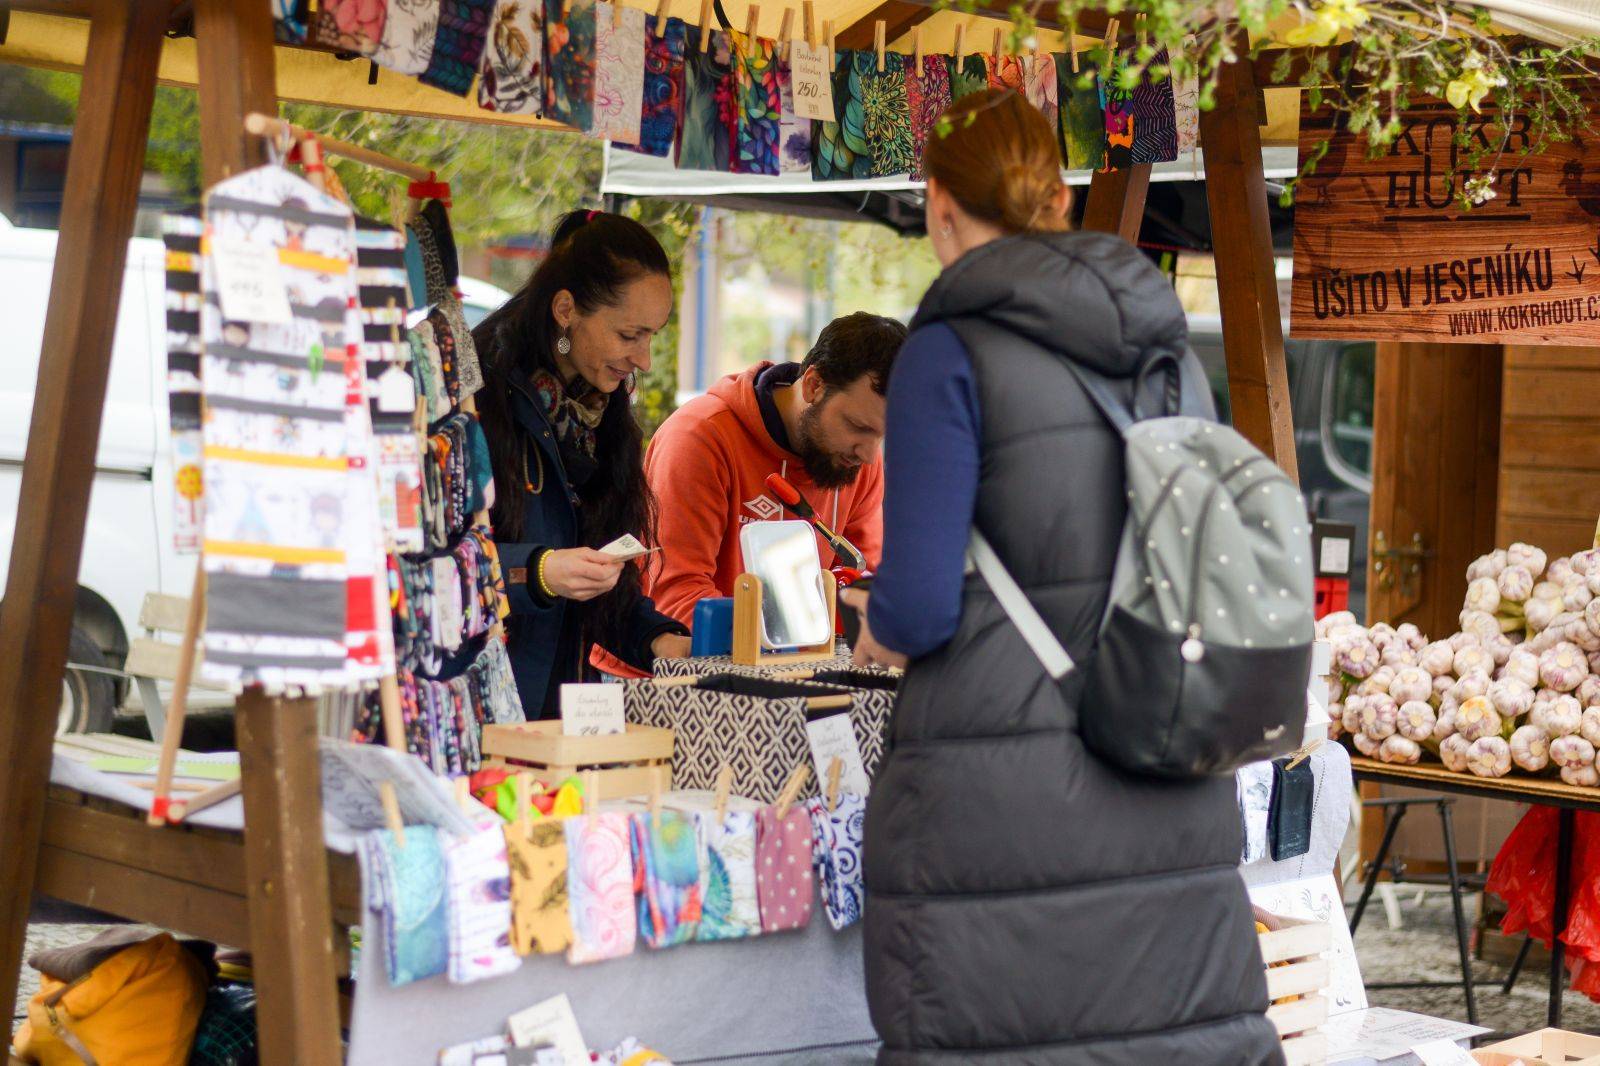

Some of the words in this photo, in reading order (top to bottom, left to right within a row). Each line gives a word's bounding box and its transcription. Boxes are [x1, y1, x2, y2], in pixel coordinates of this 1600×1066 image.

[1312, 267, 1389, 320] UŠITO
[1395, 266, 1412, 309] V
[1422, 243, 1553, 307] JESENÍKU
[1448, 294, 1600, 337] WWW.KOKRHOUT.C
